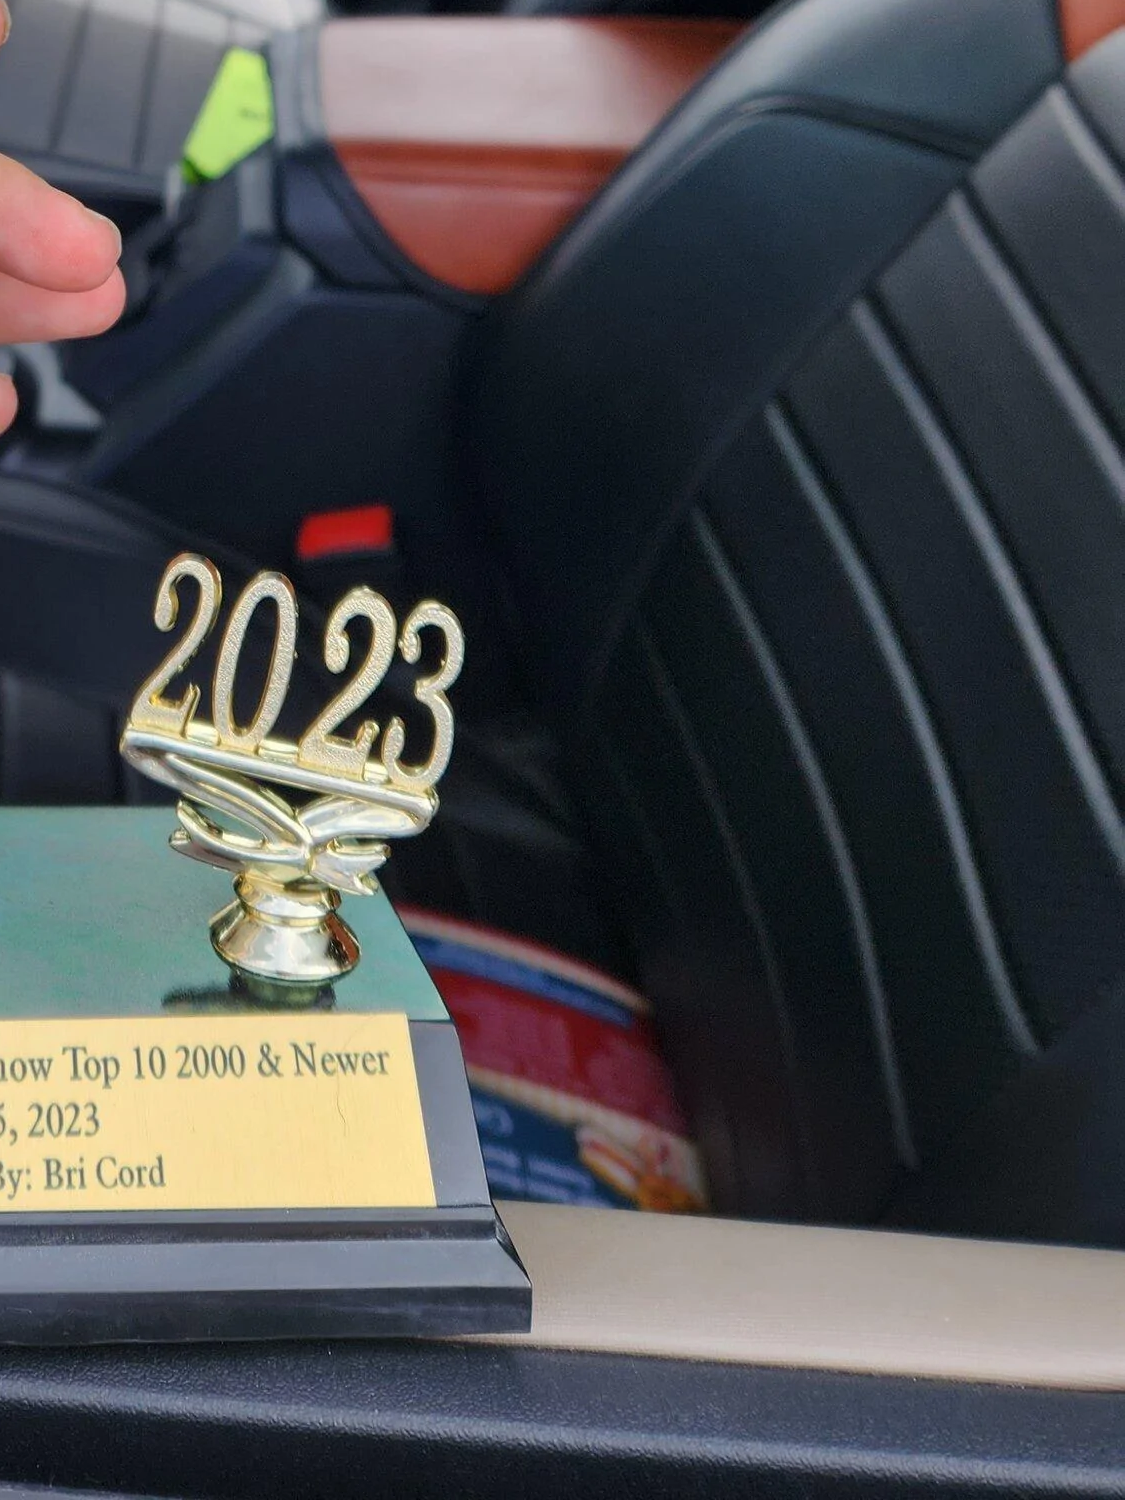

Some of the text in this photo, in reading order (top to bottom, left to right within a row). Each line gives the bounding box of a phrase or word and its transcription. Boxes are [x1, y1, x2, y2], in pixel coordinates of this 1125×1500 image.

[131, 553, 465, 788] 2023
[61, 1045, 121, 1089] Top
[133, 1045, 167, 1080] 10
[175, 1044, 246, 1079] 2000
[257, 1042, 283, 1078] &
[290, 1042, 390, 1076] Newer
[28, 1101, 100, 1138] 2023
[43, 1157, 87, 1190] Bri
[95, 1154, 166, 1189] Cord
